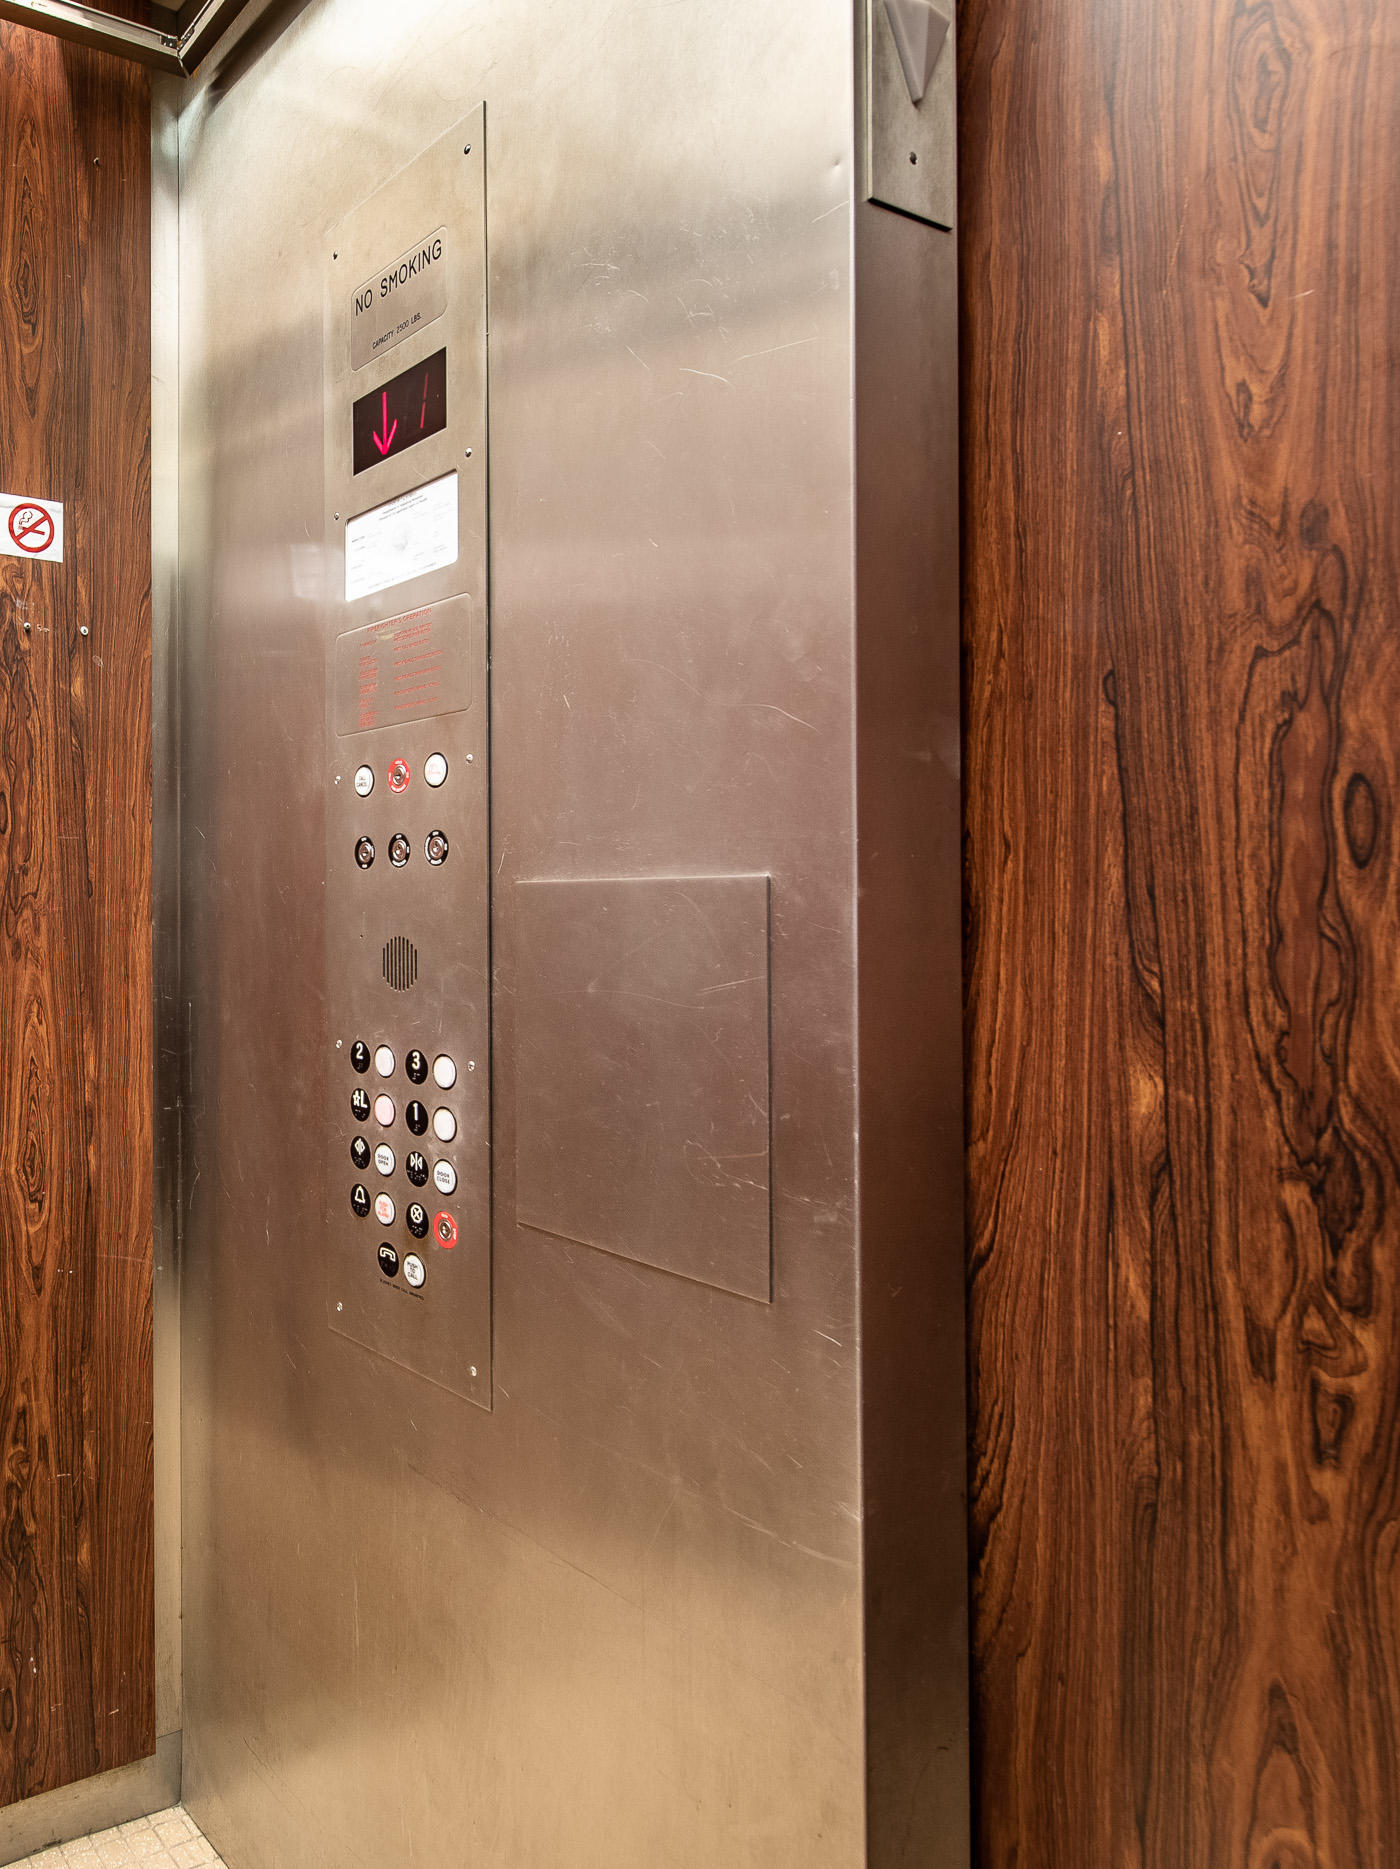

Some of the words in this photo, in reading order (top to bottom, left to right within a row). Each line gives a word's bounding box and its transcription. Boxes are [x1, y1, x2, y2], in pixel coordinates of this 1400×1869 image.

[354, 289, 373, 316] NO
[380, 239, 442, 299] SMOKING
[372, 330, 394, 350] CAPACITY
[356, 1042, 363, 1060] 2
[411, 1051, 421, 1070] 3
[413, 1102, 419, 1121] 1
